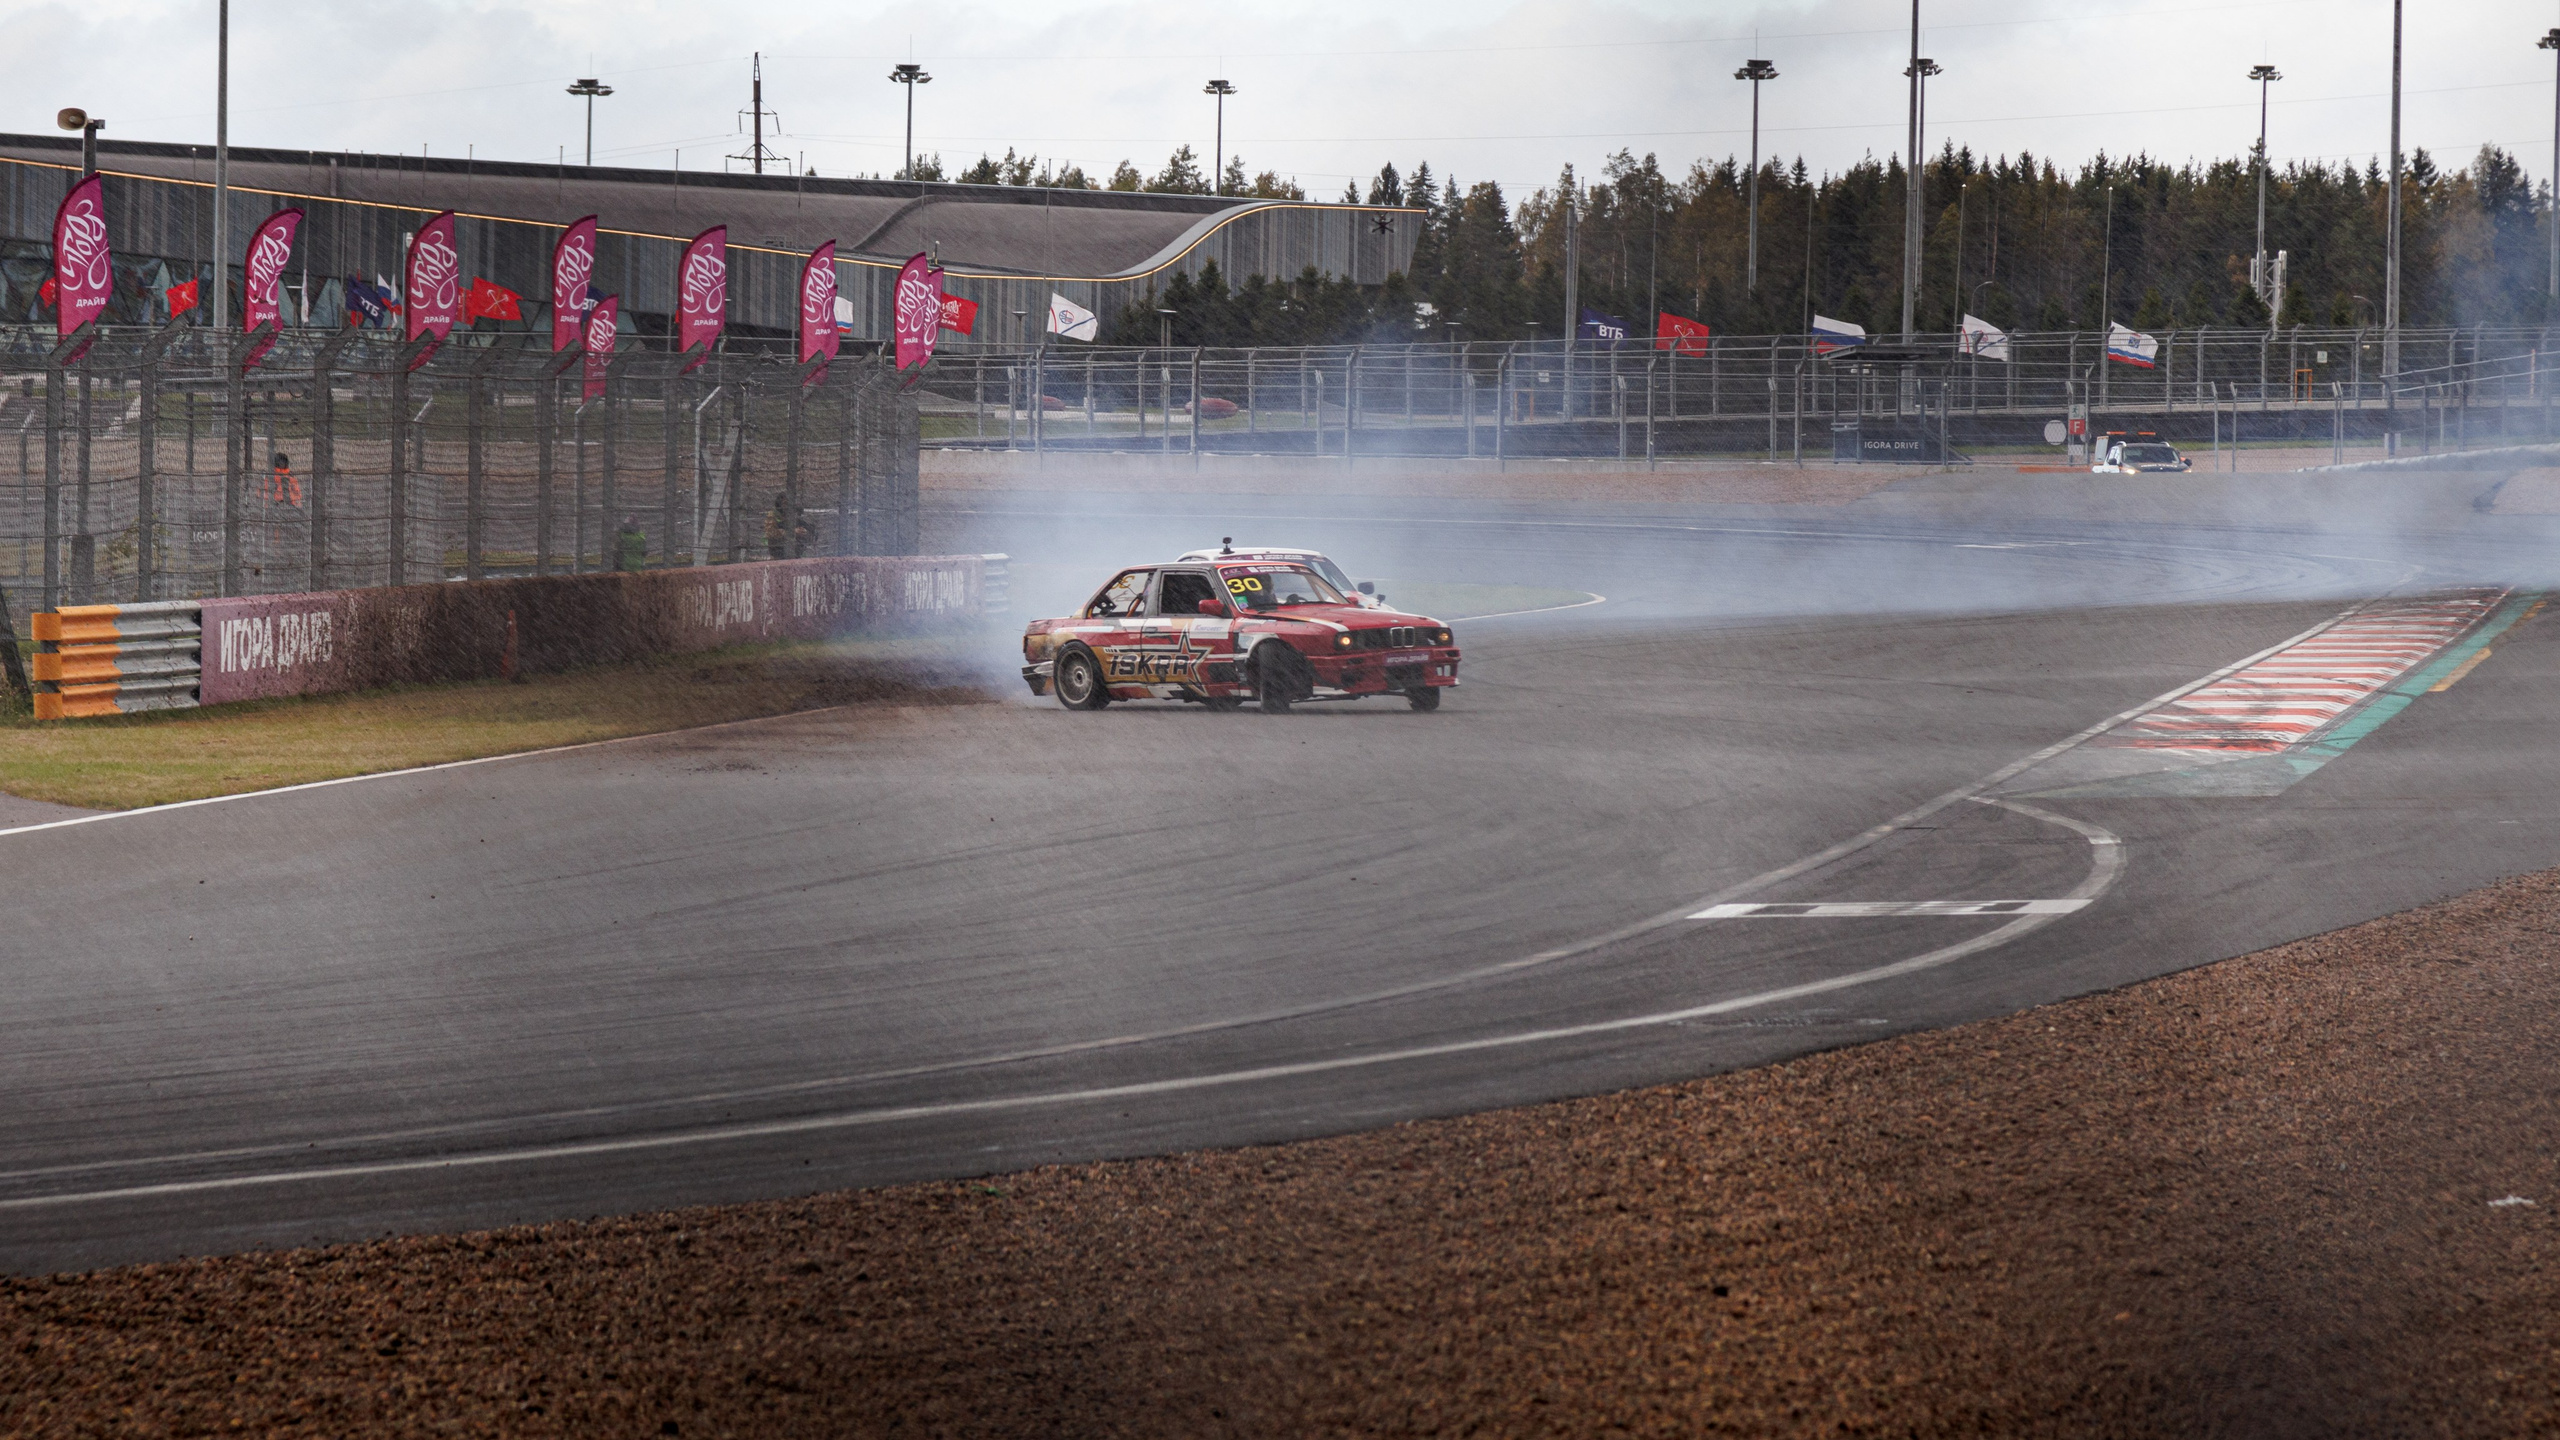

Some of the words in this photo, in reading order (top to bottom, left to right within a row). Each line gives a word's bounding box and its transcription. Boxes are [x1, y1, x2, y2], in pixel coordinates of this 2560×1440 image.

[76, 297, 106, 307] ДРАЙВ
[423, 315, 450, 323] ДРАЙВ
[1599, 325, 1624, 339] ВТБ
[2074, 421, 2081, 433] F
[1864, 441, 1891, 449] IGORA
[1894, 441, 1919, 449] DRIVE
[1227, 577, 1262, 594] 30
[220, 616, 273, 673] ИГОРА
[1109, 654, 1189, 676] ISKRA
